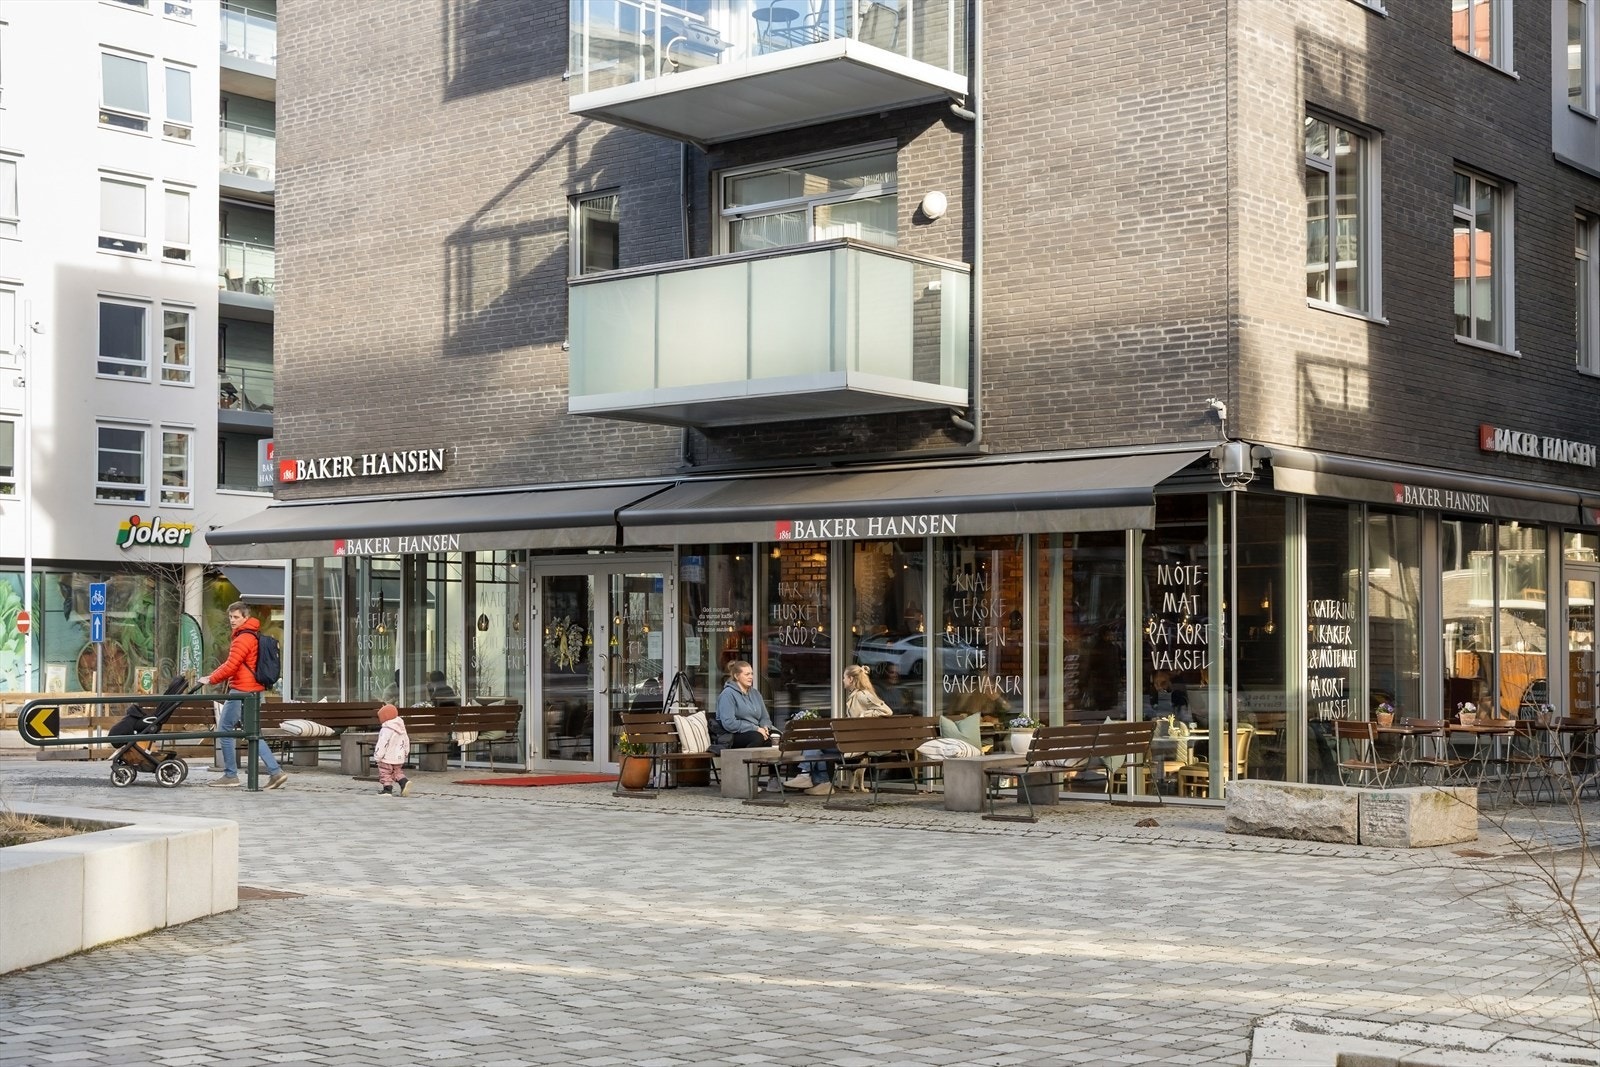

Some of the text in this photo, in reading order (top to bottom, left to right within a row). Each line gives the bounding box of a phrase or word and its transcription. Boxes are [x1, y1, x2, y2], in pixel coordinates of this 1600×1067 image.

[1494, 427, 1540, 458] BAKER
[1542, 436, 1597, 468] HANSEN
[262, 464, 274, 472] BAK
[296, 455, 356, 480] BAKER
[361, 448, 444, 476] HANSEN
[259, 474, 274, 483] HAN
[1404, 485, 1442, 508] BAKER
[1444, 490, 1490, 513] HANSEN
[122, 515, 191, 548] joker
[778, 514, 958, 540] 1861 BAKER HANSEN
[347, 536, 391, 555] BAKER
[398, 534, 461, 553] HANSEN
[778, 582, 803, 598] HAR
[773, 604, 820, 622] HUSKET
[952, 596, 1006, 621] FERSKE
[1162, 592, 1200, 616] MAT
[356, 634, 390, 650] BESTILL
[946, 626, 1006, 647] GLUTEN
[1149, 619, 1168, 645] PÅ
[1176, 623, 1212, 645] KORT
[1320, 624, 1352, 645] KAKER
[956, 646, 987, 670] FRIE
[1151, 649, 1214, 672] VARSEL
[942, 674, 1022, 696] BAKEVARER
[1321, 678, 1346, 698] KORT
